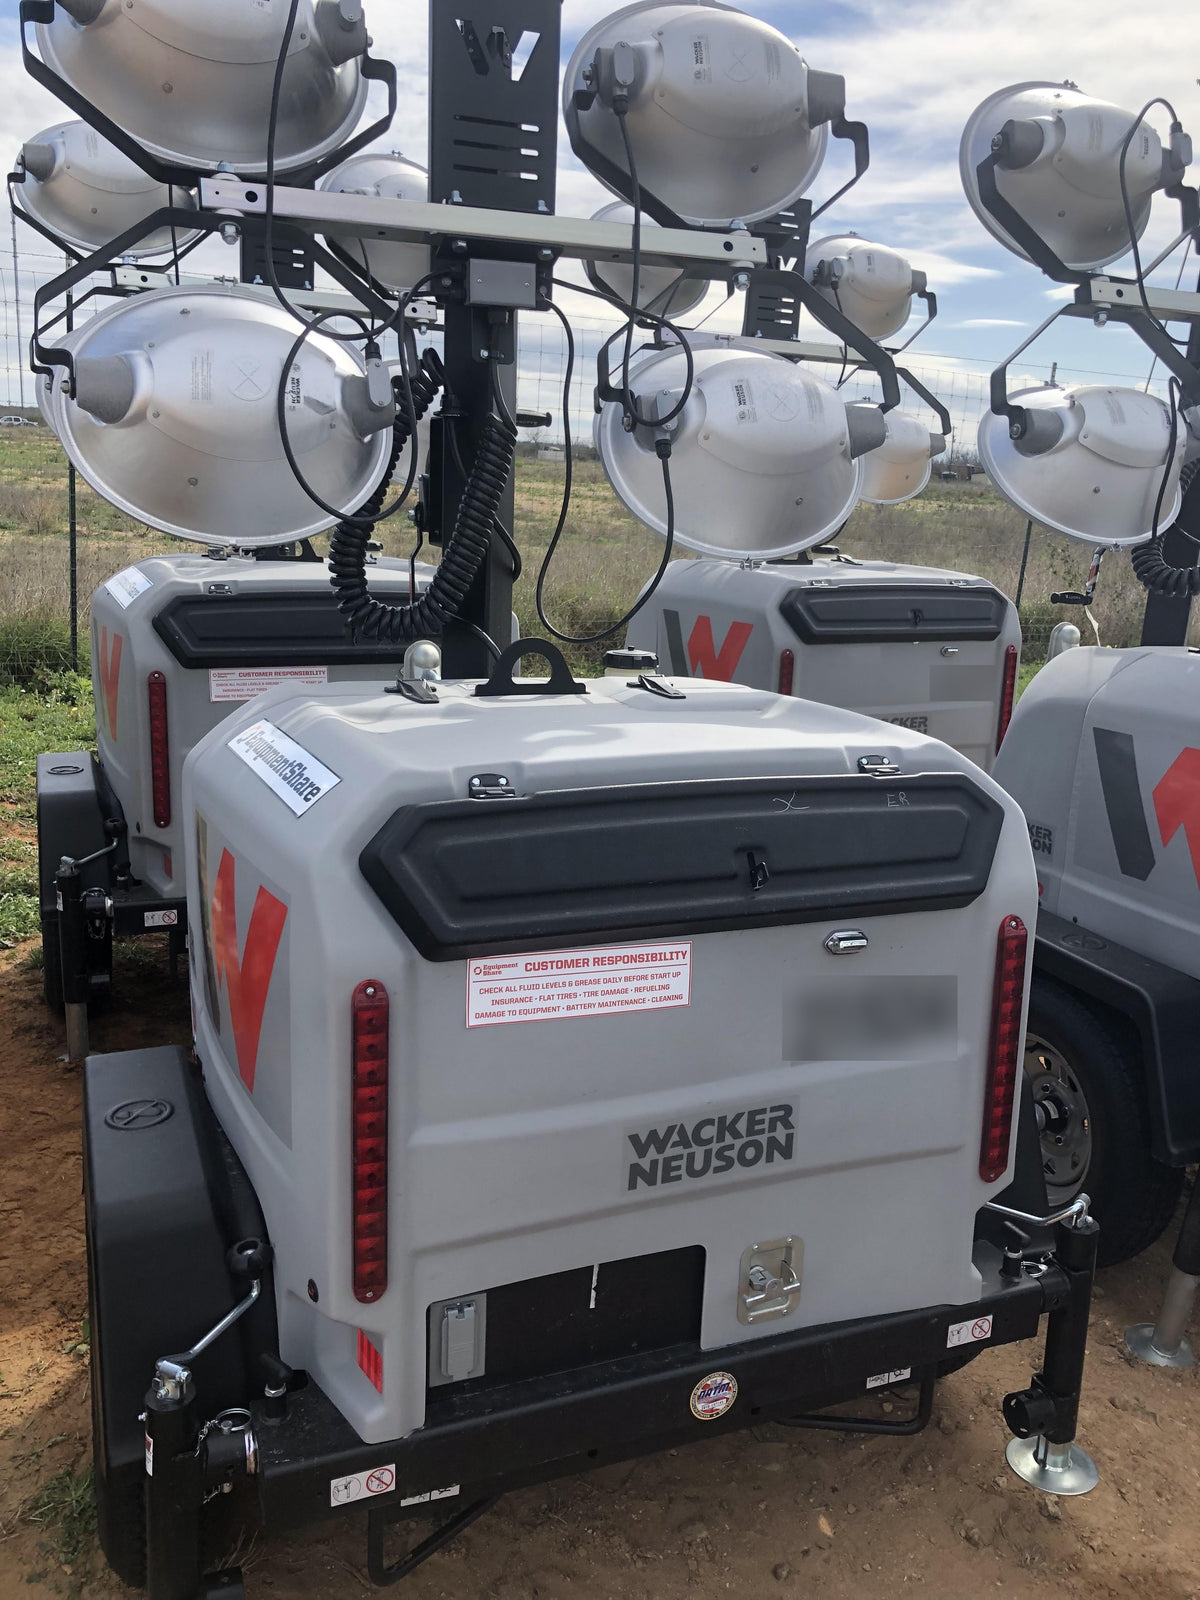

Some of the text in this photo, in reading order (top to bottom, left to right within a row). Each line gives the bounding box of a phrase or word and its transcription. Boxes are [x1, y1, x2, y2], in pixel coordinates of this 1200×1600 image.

[483, 962, 519, 971] Equipment
[524, 950, 688, 972] CUSTOMER RESPONSIBILITY
[479, 987, 503, 995] CHECK
[541, 981, 567, 989] LEVELS
[574, 978, 602, 987] GREASE
[623, 974, 649, 982] BEFORE
[650, 972, 671, 980] START
[491, 996, 534, 1006] INSURANCE
[538, 994, 555, 1002] FLAT
[556, 992, 578, 1000] TIRES
[600, 987, 629, 996] DAMAGE
[634, 984, 671, 993] REFUELING
[474, 1011, 506, 1019] DAMAGE
[518, 1006, 561, 1015] EQUIPMENT
[566, 1003, 596, 1012] BATTERY
[598, 998, 646, 1008] MAINTENANCE
[651, 994, 683, 1003] CLEANING
[628, 1104, 796, 1159] WACKER
[627, 1132, 795, 1191] NEUSON
